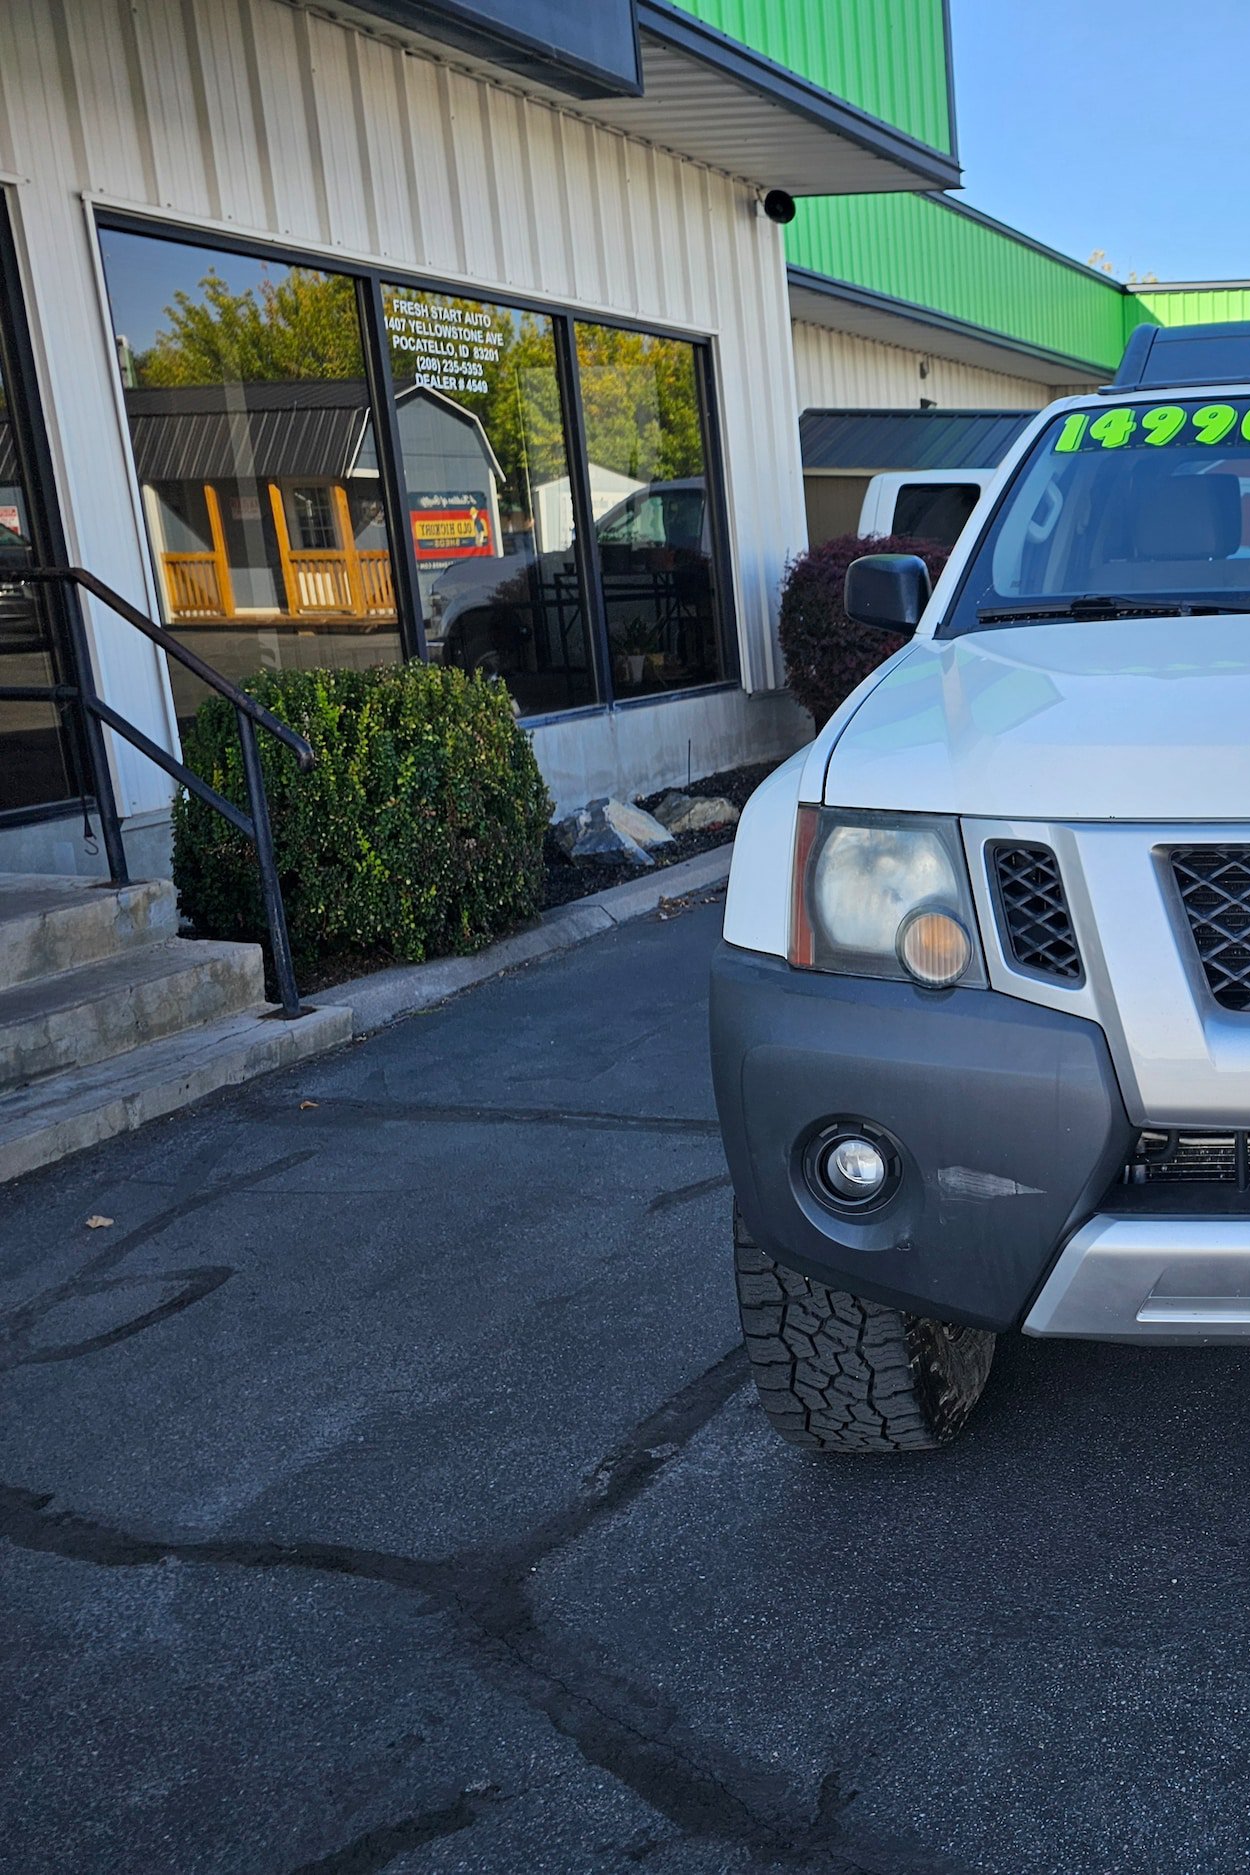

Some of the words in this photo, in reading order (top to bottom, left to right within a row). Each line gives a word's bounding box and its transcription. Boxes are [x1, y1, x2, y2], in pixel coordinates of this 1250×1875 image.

[393, 299, 429, 318] FRESH
[431, 305, 462, 322] START
[464, 311, 491, 328] AUTO
[384, 316, 406, 332] 1407
[408, 319, 484, 343] YELLOWSTONE
[485, 331, 504, 347] AVE
[392, 335, 458, 358] POCATELLO,
[458, 344, 469, 358] ID
[473, 346, 499, 362] 83201
[416, 355, 441, 374] (208)
[442, 359, 484, 377] 235-5353
[415, 373, 457, 390] DEALER
[466, 378, 489, 393] 4549
